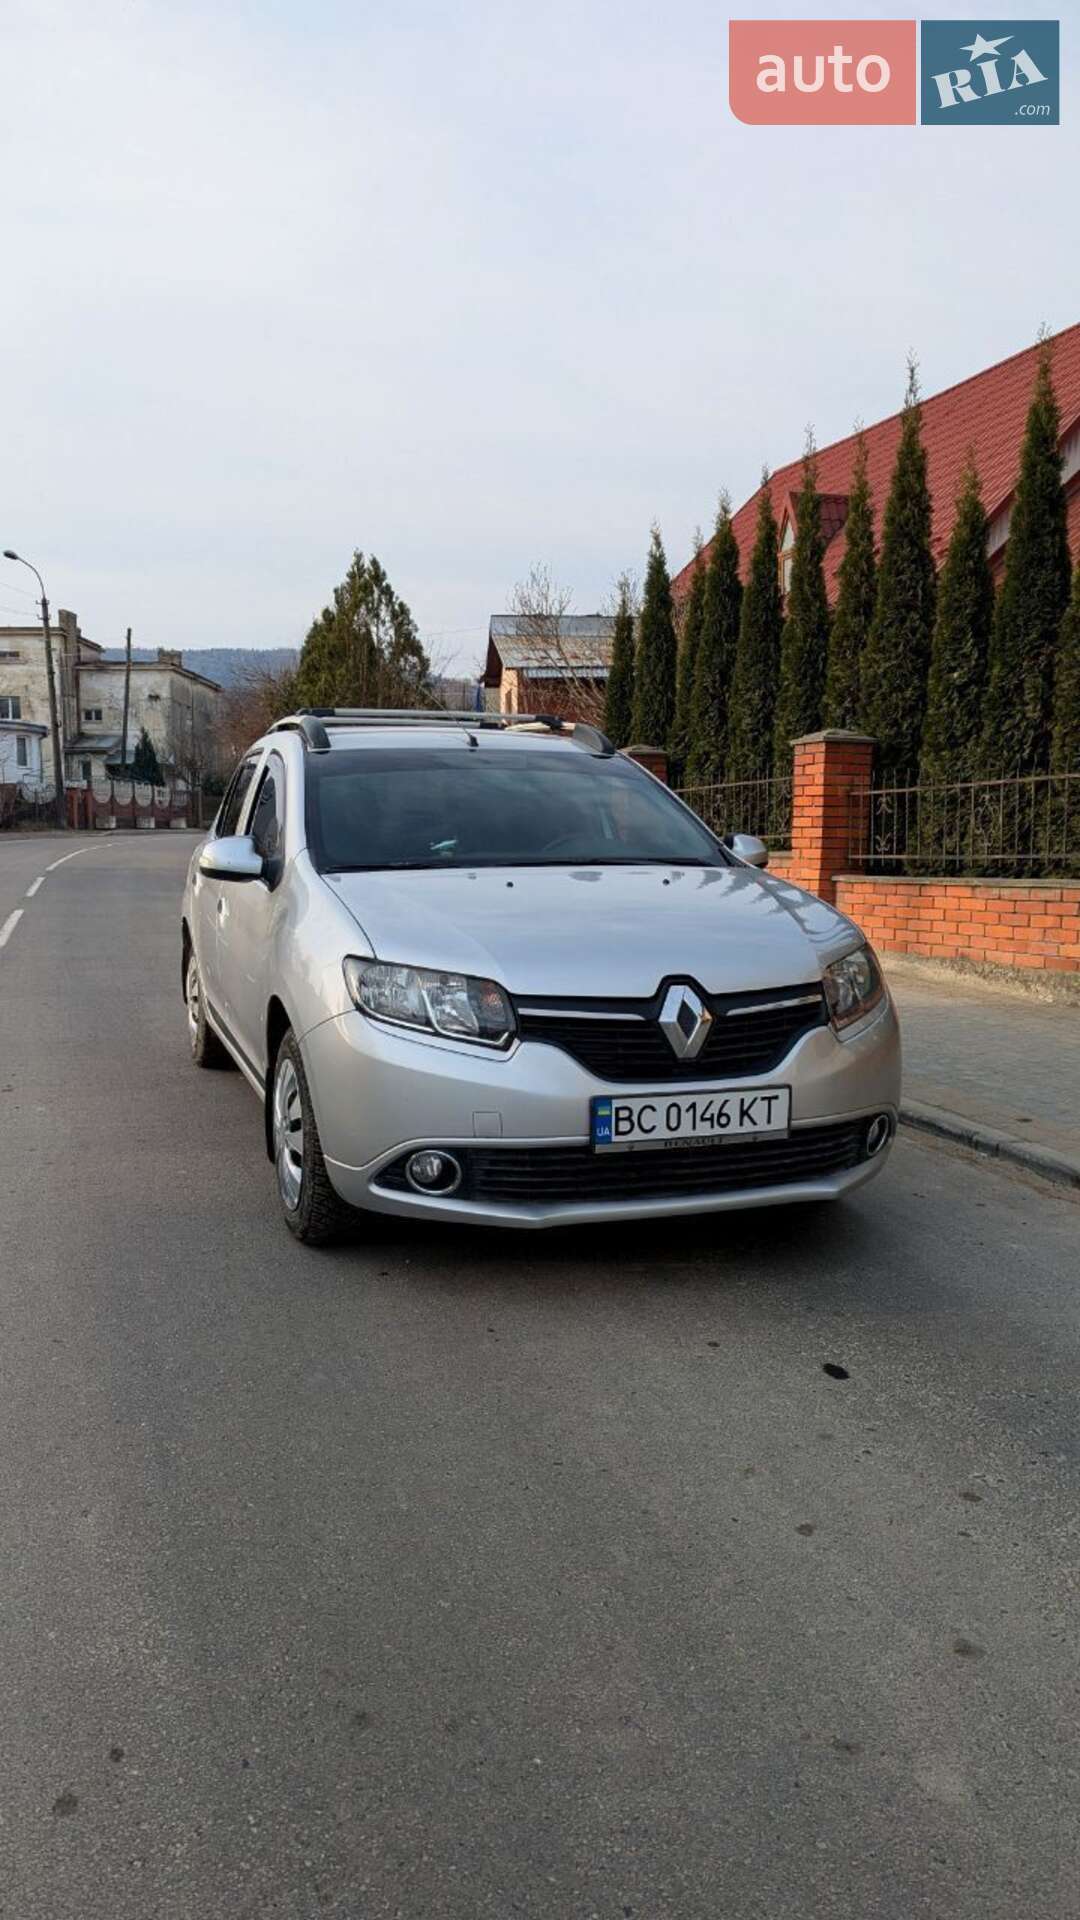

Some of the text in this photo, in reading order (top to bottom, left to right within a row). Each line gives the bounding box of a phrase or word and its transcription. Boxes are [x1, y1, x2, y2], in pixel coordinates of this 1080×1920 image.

[614, 1095, 779, 1136] BC 0146 KT
[596, 1126, 610, 1137] UA
